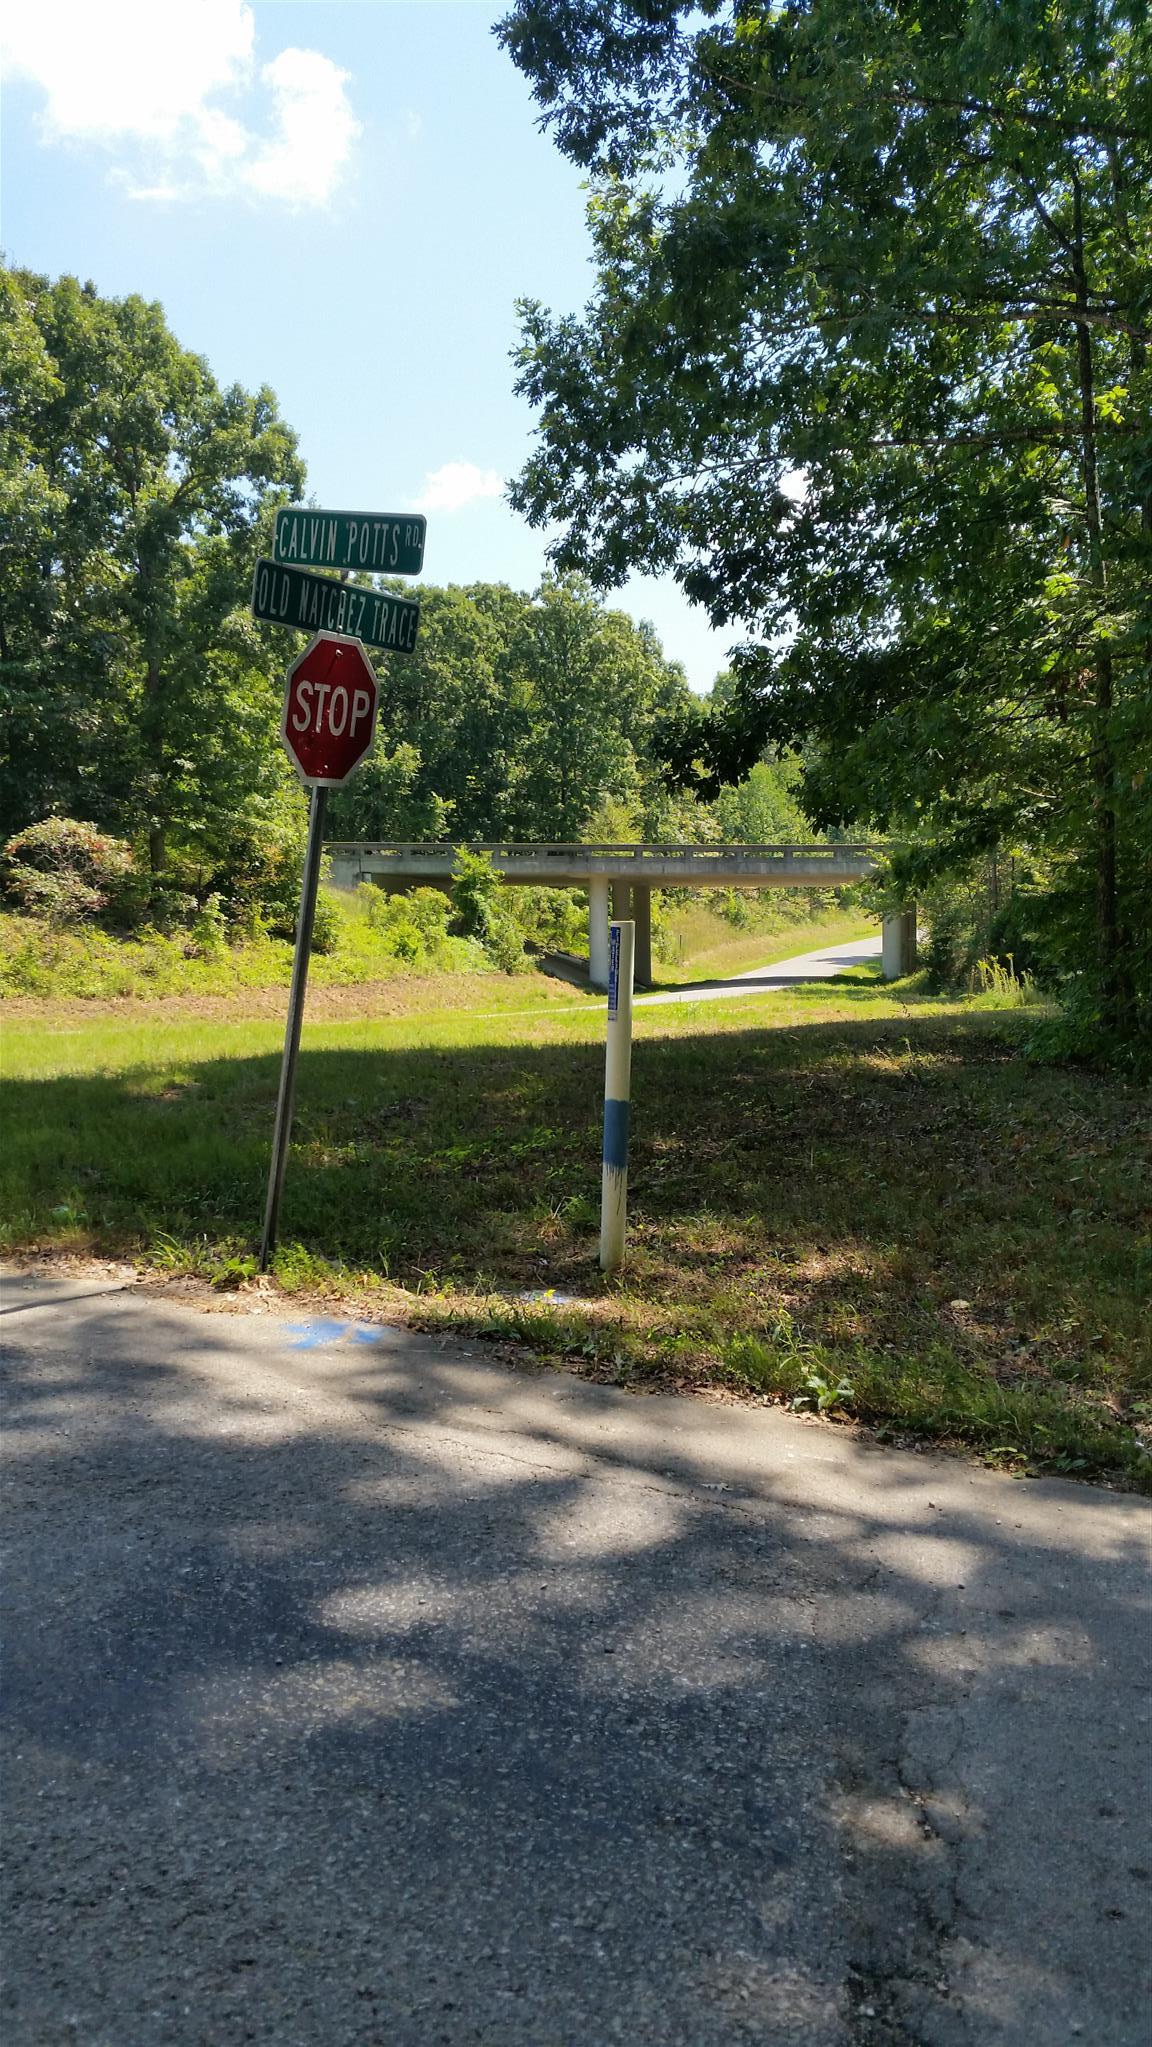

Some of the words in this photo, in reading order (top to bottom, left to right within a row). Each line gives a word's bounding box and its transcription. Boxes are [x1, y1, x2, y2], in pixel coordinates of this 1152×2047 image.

[279, 516, 338, 561] CALVIN
[346, 521, 400, 566] POTTS
[258, 568, 290, 616] OLD
[299, 579, 366, 637] NATCHEZ
[371, 600, 416, 648] TRACE
[292, 680, 370, 737] STOP
